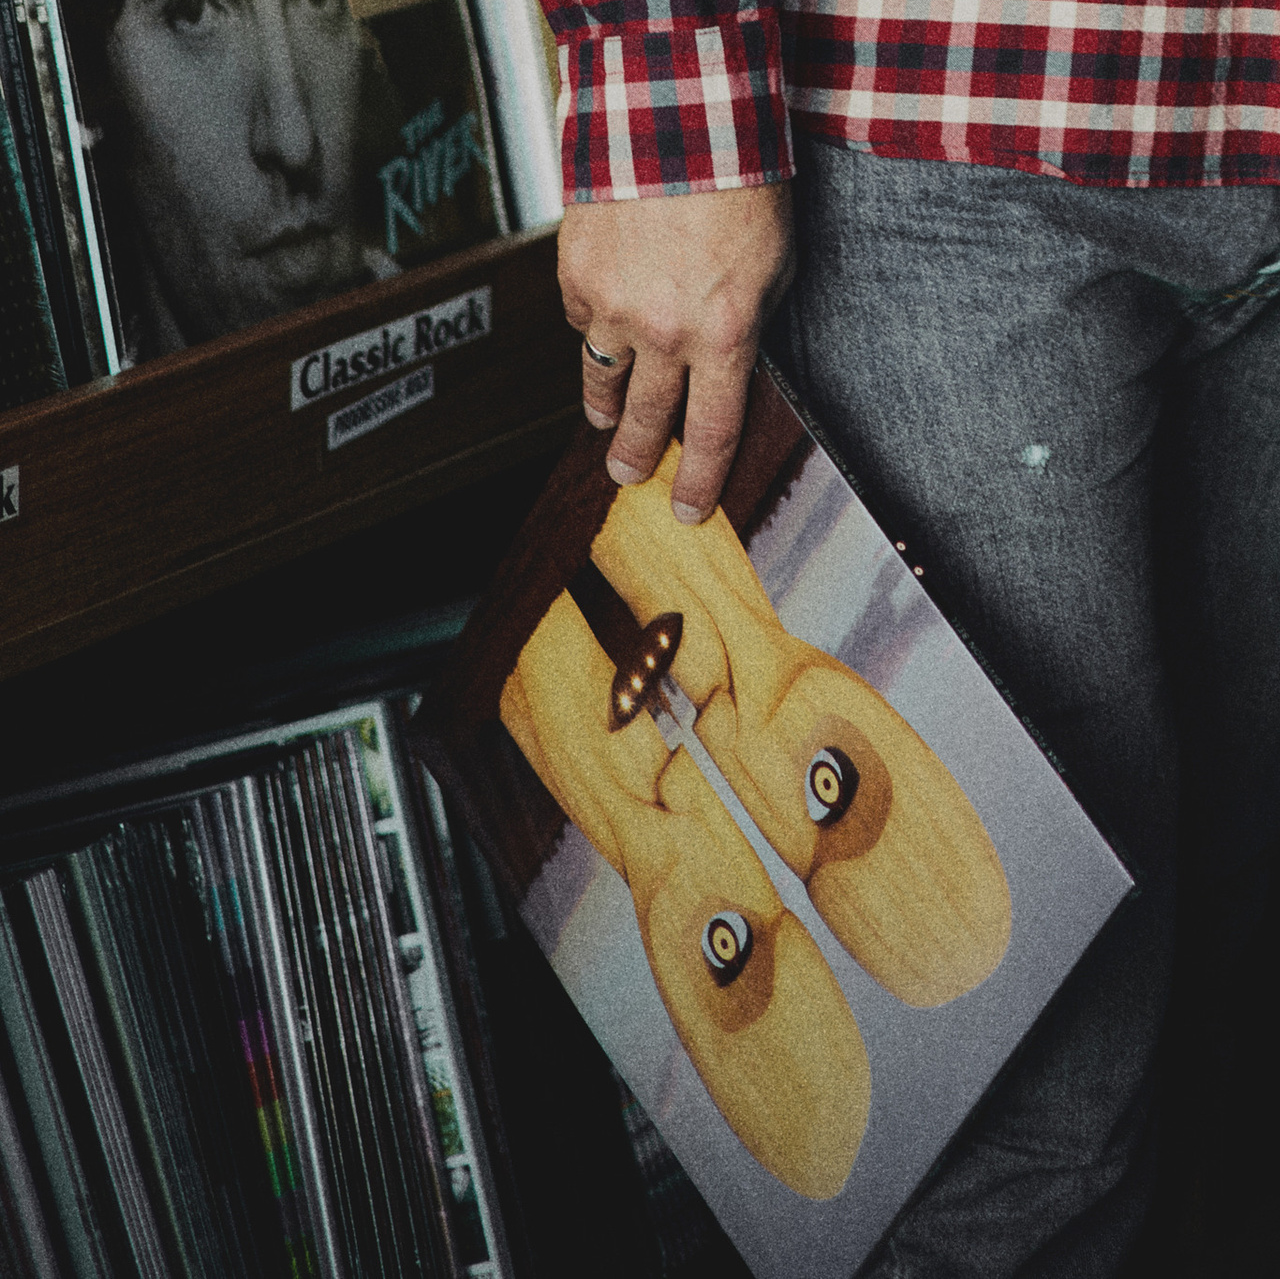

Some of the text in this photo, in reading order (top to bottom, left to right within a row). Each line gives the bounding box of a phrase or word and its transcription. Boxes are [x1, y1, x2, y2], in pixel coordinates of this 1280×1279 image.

[376, 111, 489, 255] RIVER
[300, 296, 485, 399] Classic Rock
